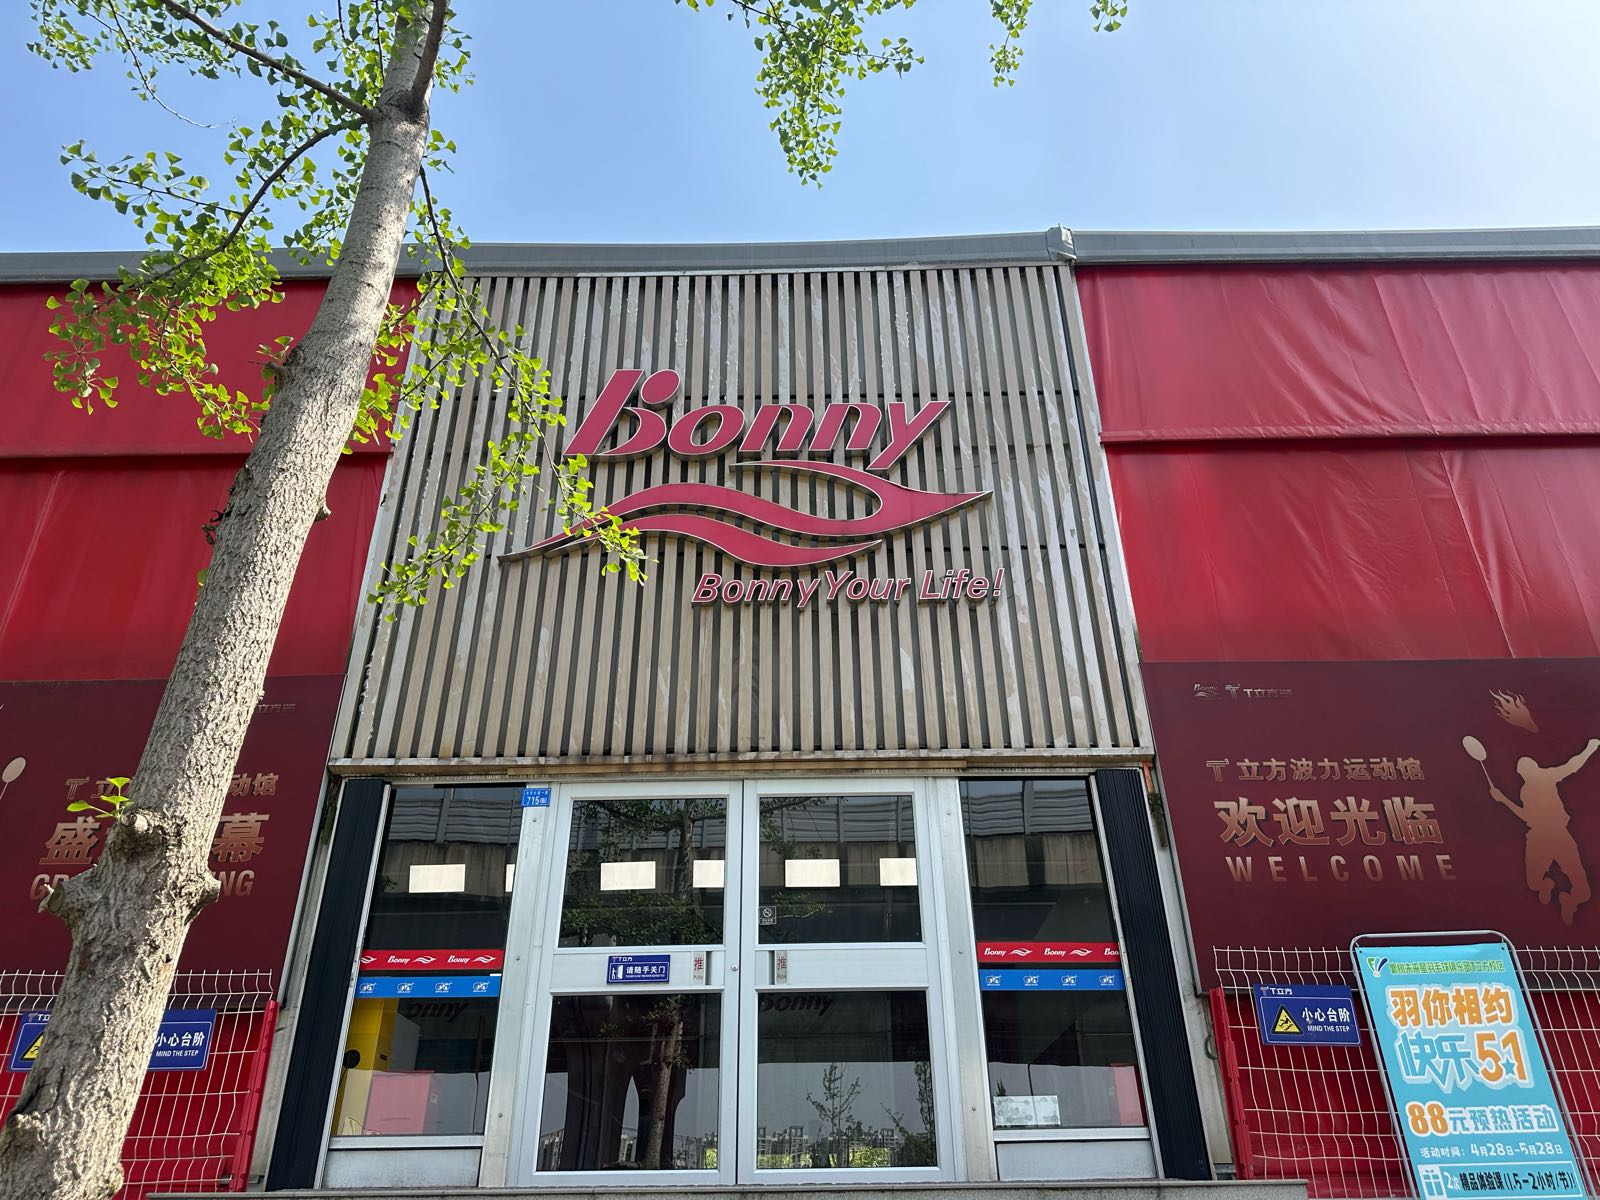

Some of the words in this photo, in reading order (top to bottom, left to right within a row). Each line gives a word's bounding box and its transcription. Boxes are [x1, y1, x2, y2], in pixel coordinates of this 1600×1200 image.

[563, 368, 952, 470] Bonny
[691, 573, 820, 608] Bonny
[825, 570, 911, 602] Your
[918, 568, 1005, 601] Life!
[1213, 795, 1444, 847] 欢迎光临
[1225, 854, 1457, 882] WELCOME
[984, 947, 1007, 957] Bonny
[1044, 947, 1067, 957] Bonny
[1103, 947, 1120, 956] Bon
[387, 955, 411, 965] Bonny
[447, 955, 471, 964] Bonny
[626, 965, 666, 975] 请随手关门
[1389, 986, 1514, 1027] 羽你相约
[1302, 1007, 1350, 1023] 小心台阶
[155, 1032, 205, 1047] 小心台阶
[184, 1049, 199, 1057] STEP
